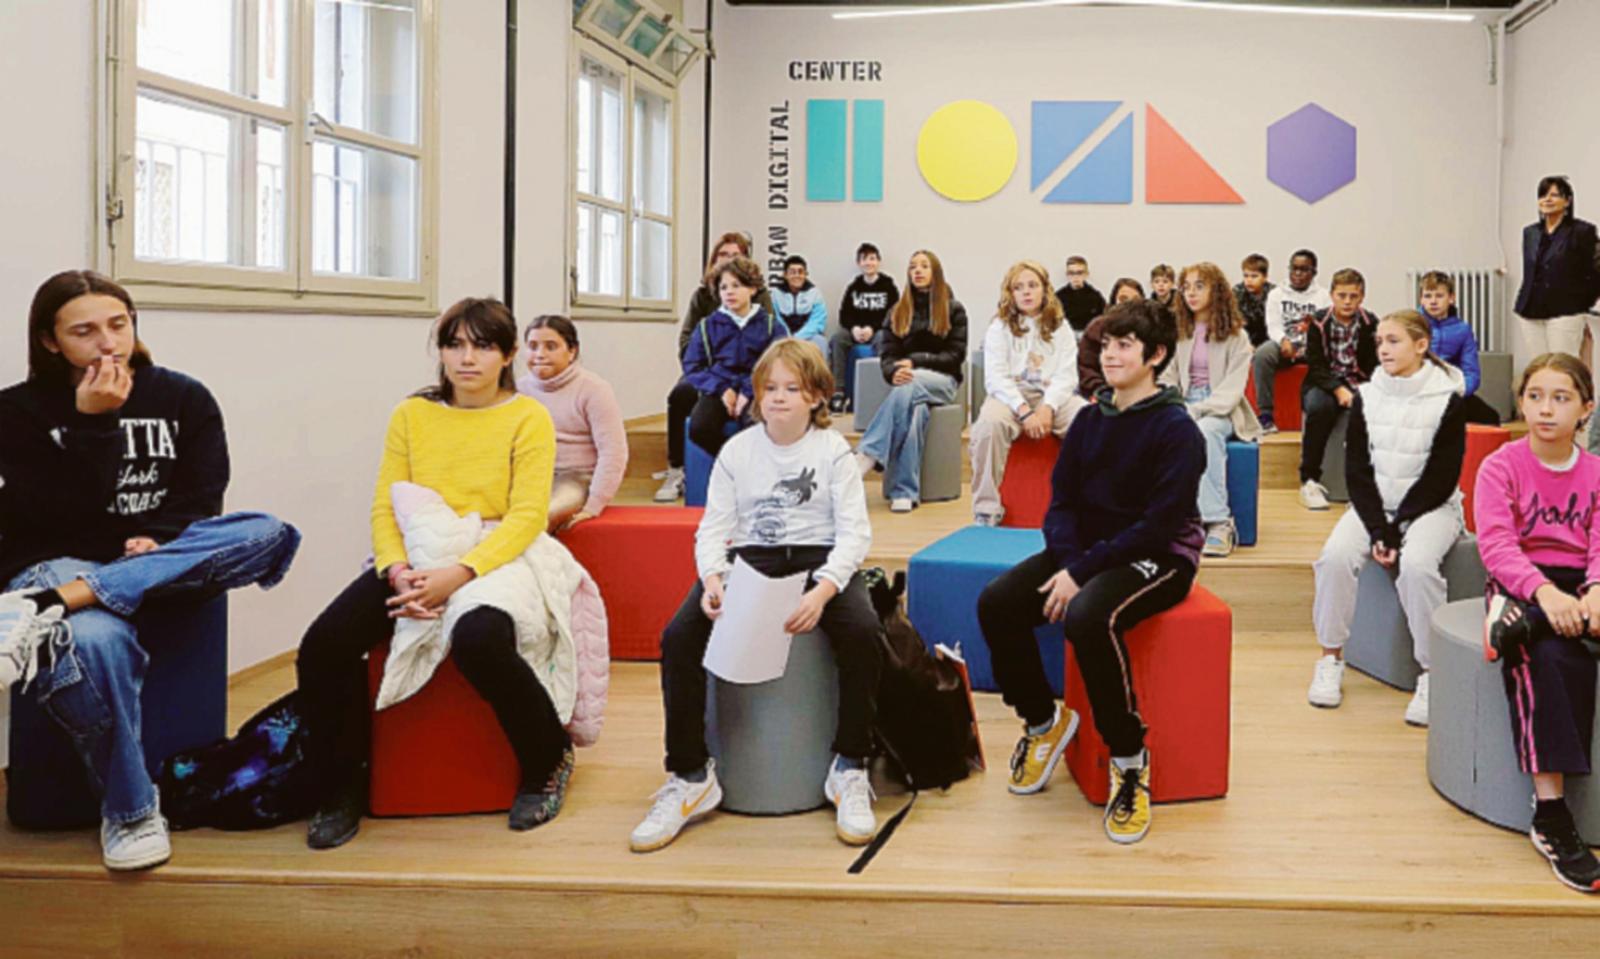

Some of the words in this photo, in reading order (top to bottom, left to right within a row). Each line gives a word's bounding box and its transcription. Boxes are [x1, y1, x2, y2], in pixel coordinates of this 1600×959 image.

[788, 60, 882, 82] CENTER
[768, 99, 789, 209] DIGITAL
[767, 226, 789, 289] RBAN
